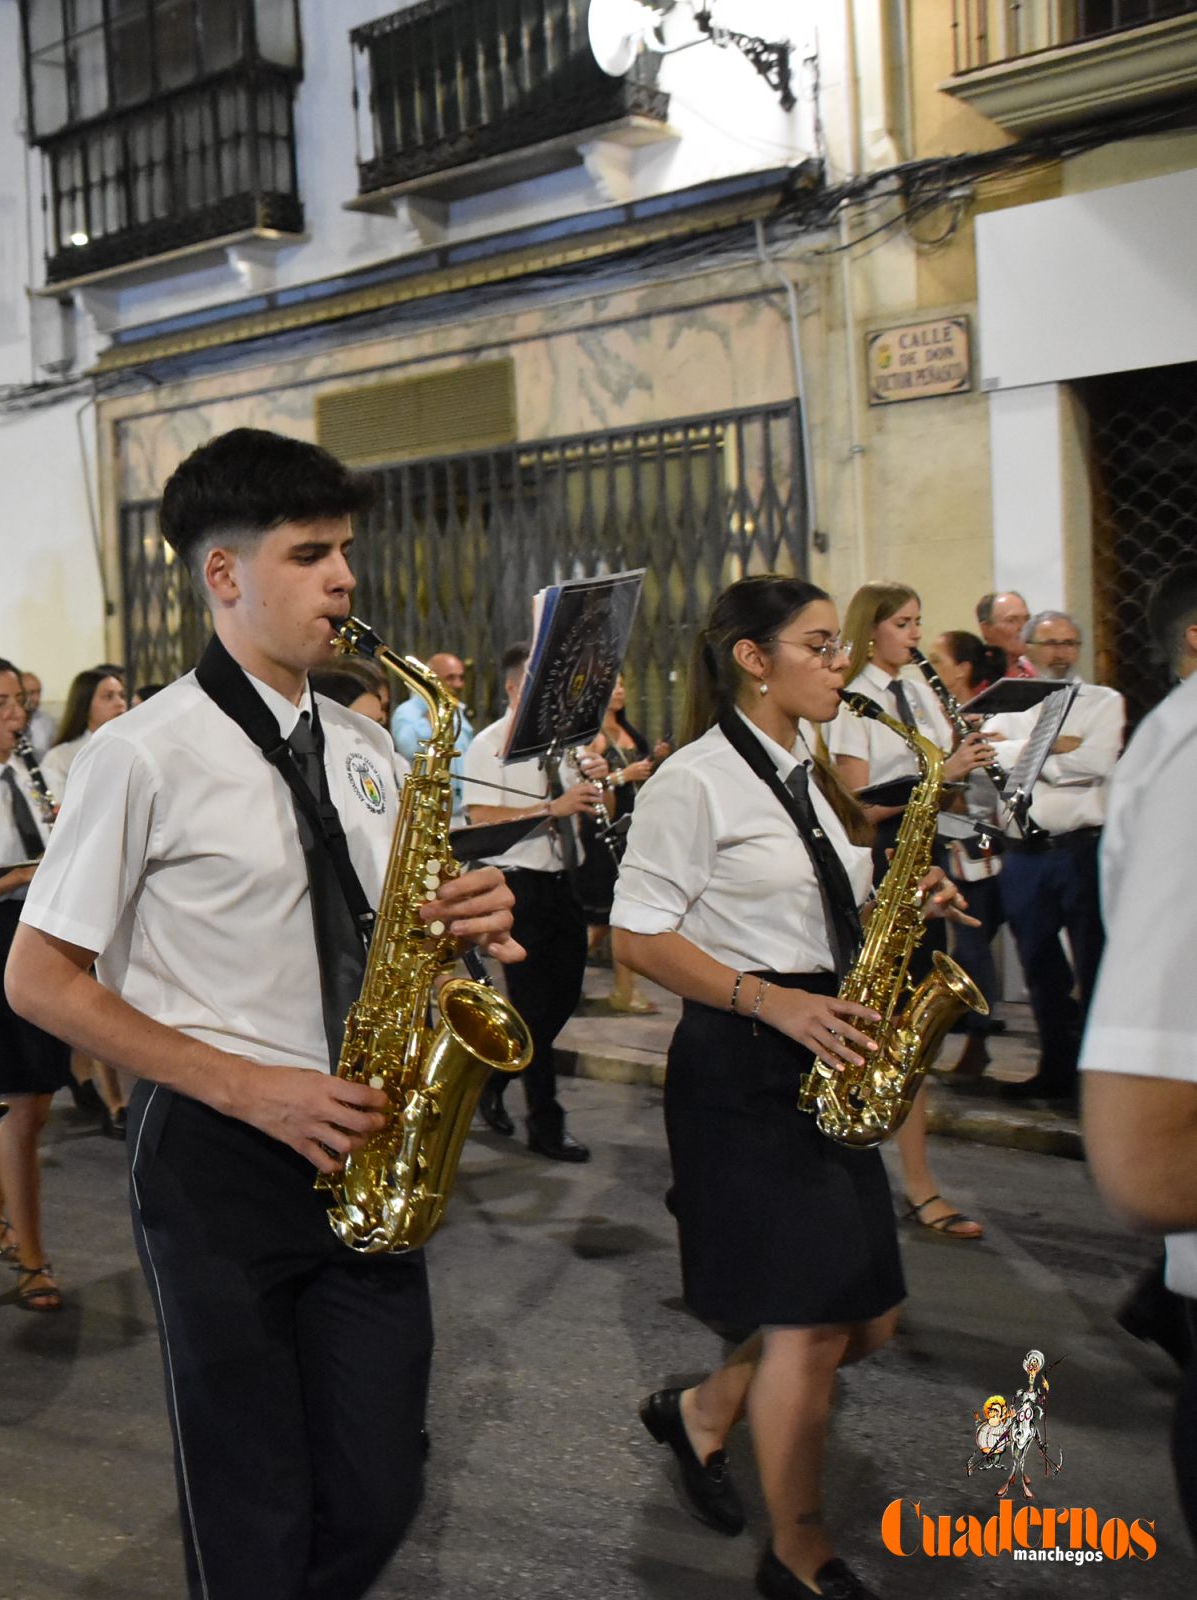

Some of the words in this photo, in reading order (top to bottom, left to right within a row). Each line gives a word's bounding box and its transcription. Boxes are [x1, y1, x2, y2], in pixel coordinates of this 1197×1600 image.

[899, 326, 952, 349] CALLE
[899, 352, 917, 367] DE
[925, 346, 954, 362] DON
